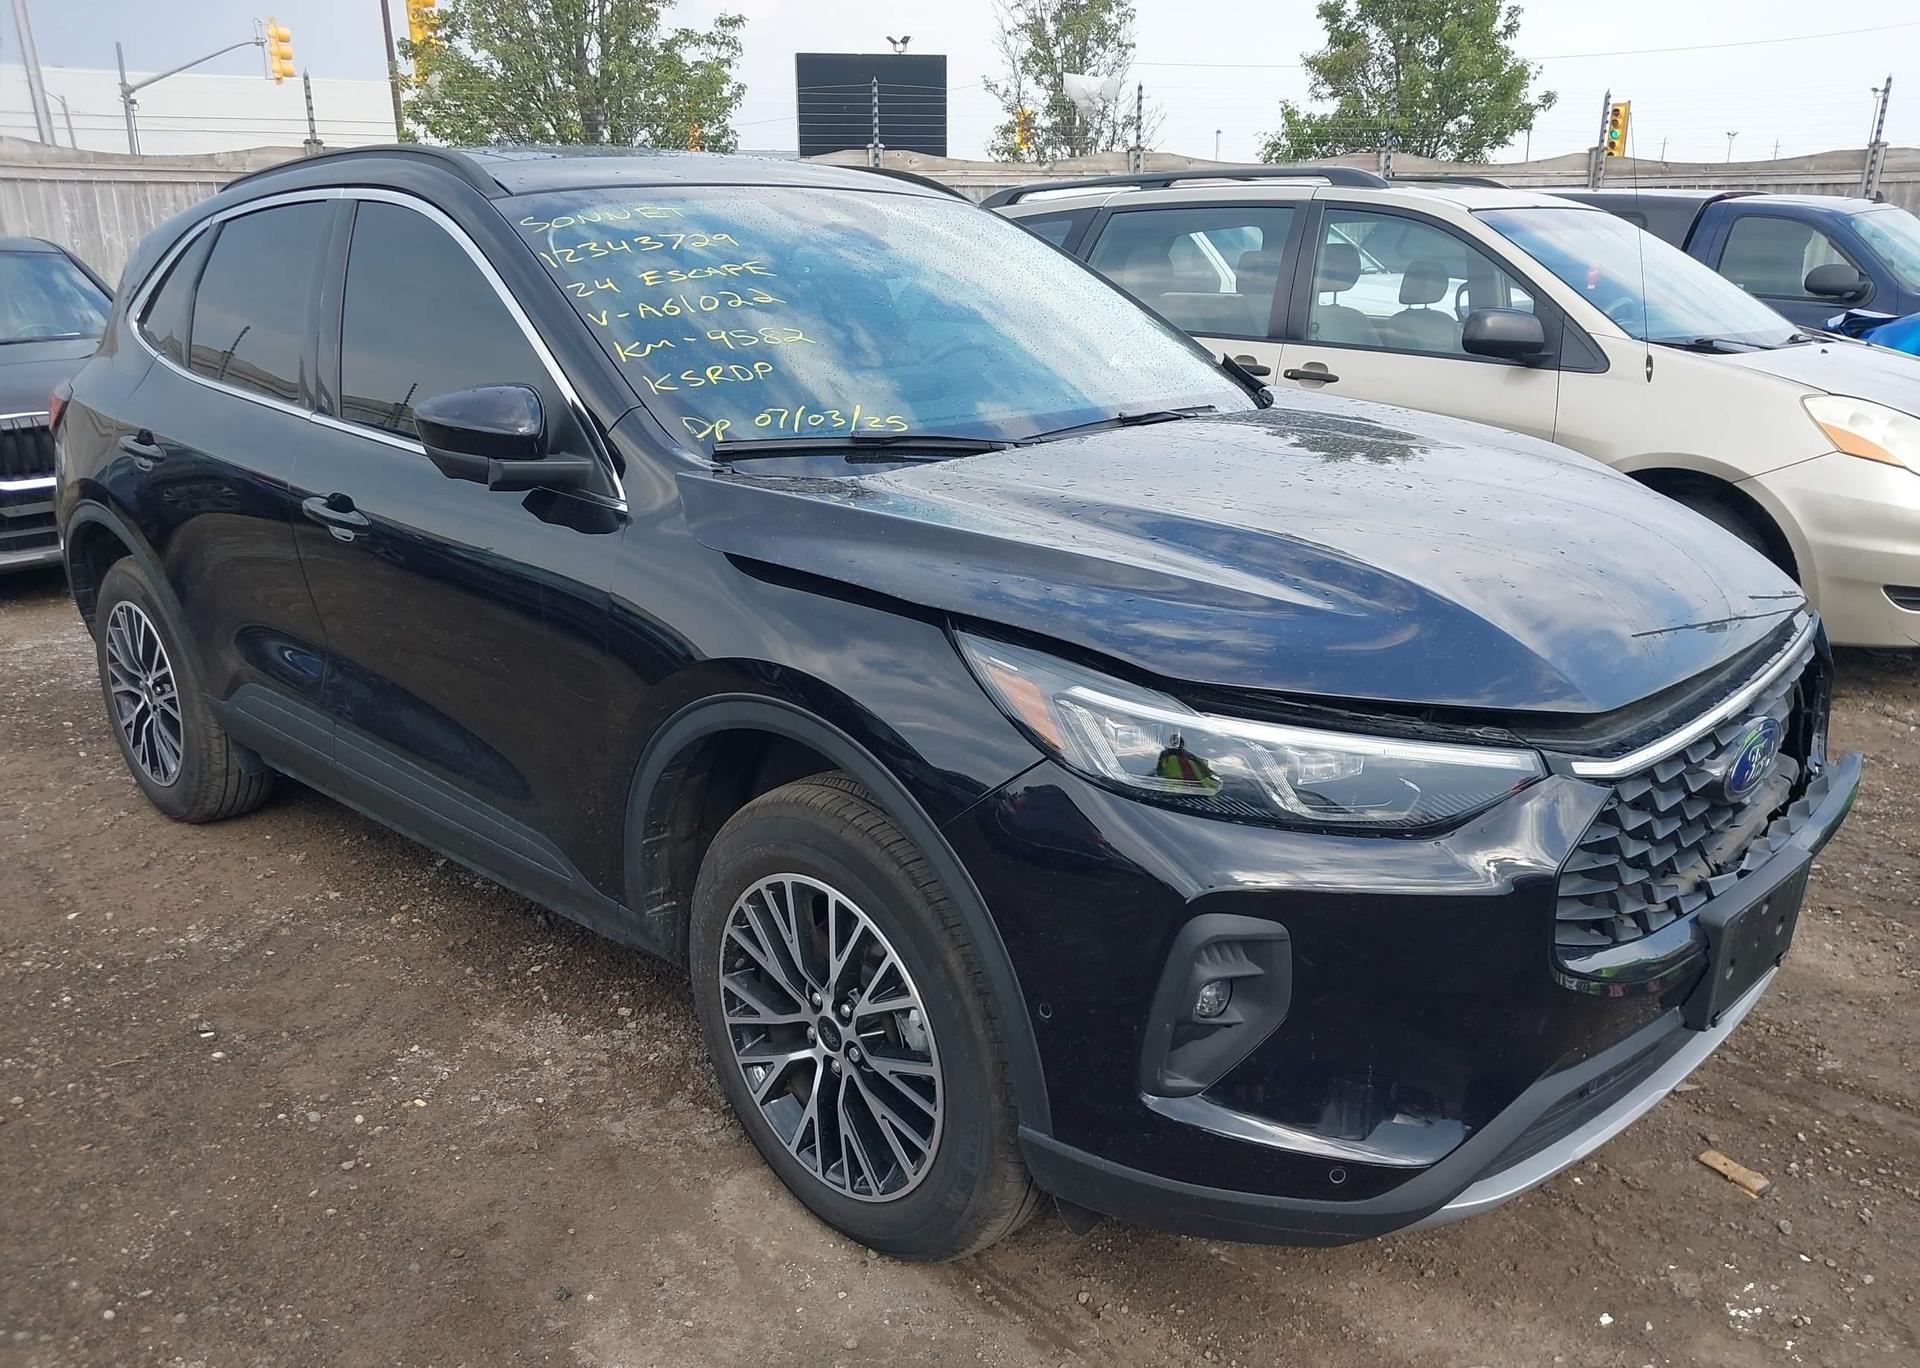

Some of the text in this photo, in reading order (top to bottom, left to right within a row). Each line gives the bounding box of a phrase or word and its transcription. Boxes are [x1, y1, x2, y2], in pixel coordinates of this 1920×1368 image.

[520, 206, 686, 233] SONNET
[539, 233, 741, 269] 12343729
[566, 261, 777, 298] 24 ESCAPE
[754, 404, 908, 433] 07/03/25
